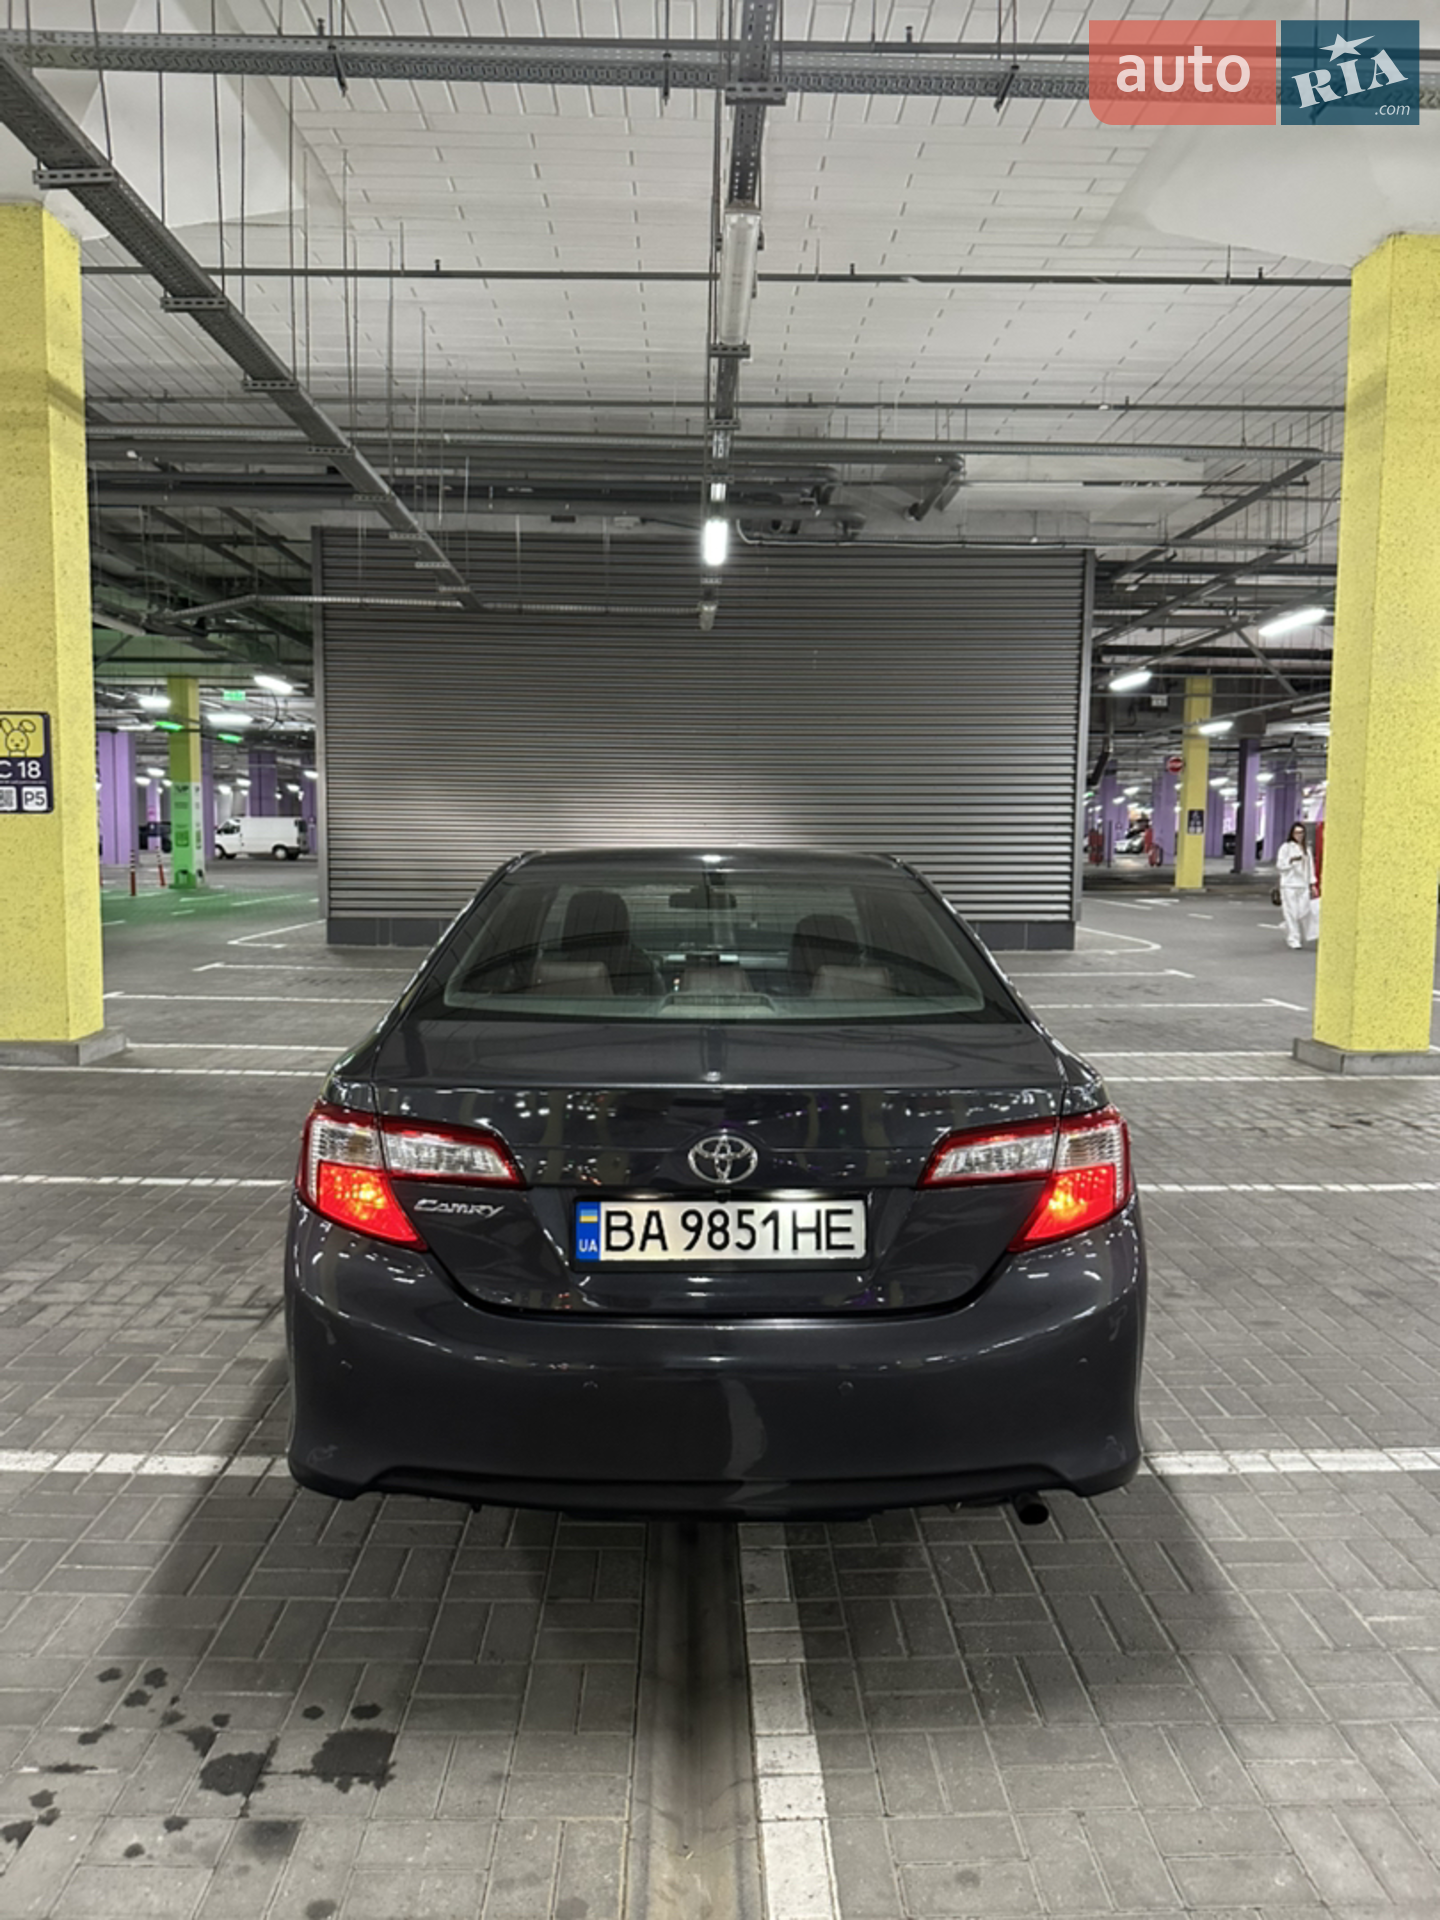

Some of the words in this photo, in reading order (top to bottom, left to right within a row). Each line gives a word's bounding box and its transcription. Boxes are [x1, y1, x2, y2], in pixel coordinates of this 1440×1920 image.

[17, 760, 41, 779] 18
[24, 791, 45, 806] P5
[578, 1240, 598, 1253] UA
